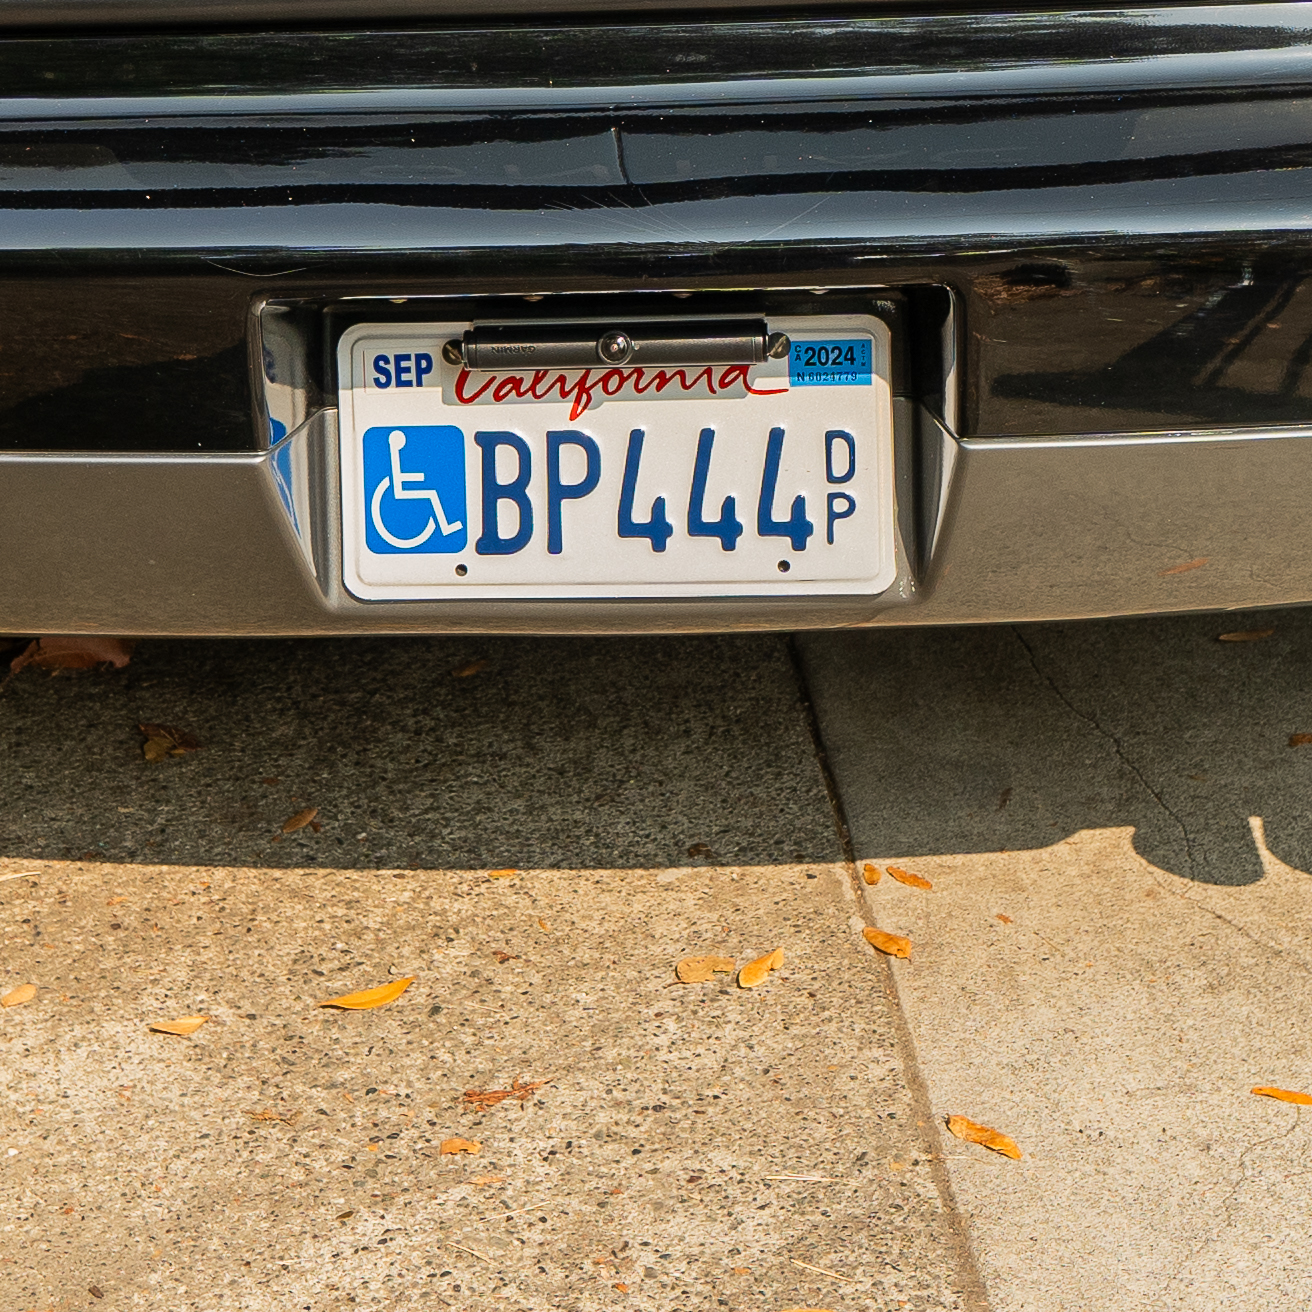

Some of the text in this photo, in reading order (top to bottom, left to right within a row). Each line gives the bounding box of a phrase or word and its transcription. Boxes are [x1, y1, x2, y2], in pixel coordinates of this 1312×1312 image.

[491, 345, 537, 356] GARMIN
[804, 345, 856, 367] 2024
[373, 353, 433, 389] SEP
[474, 426, 814, 555] BP444
